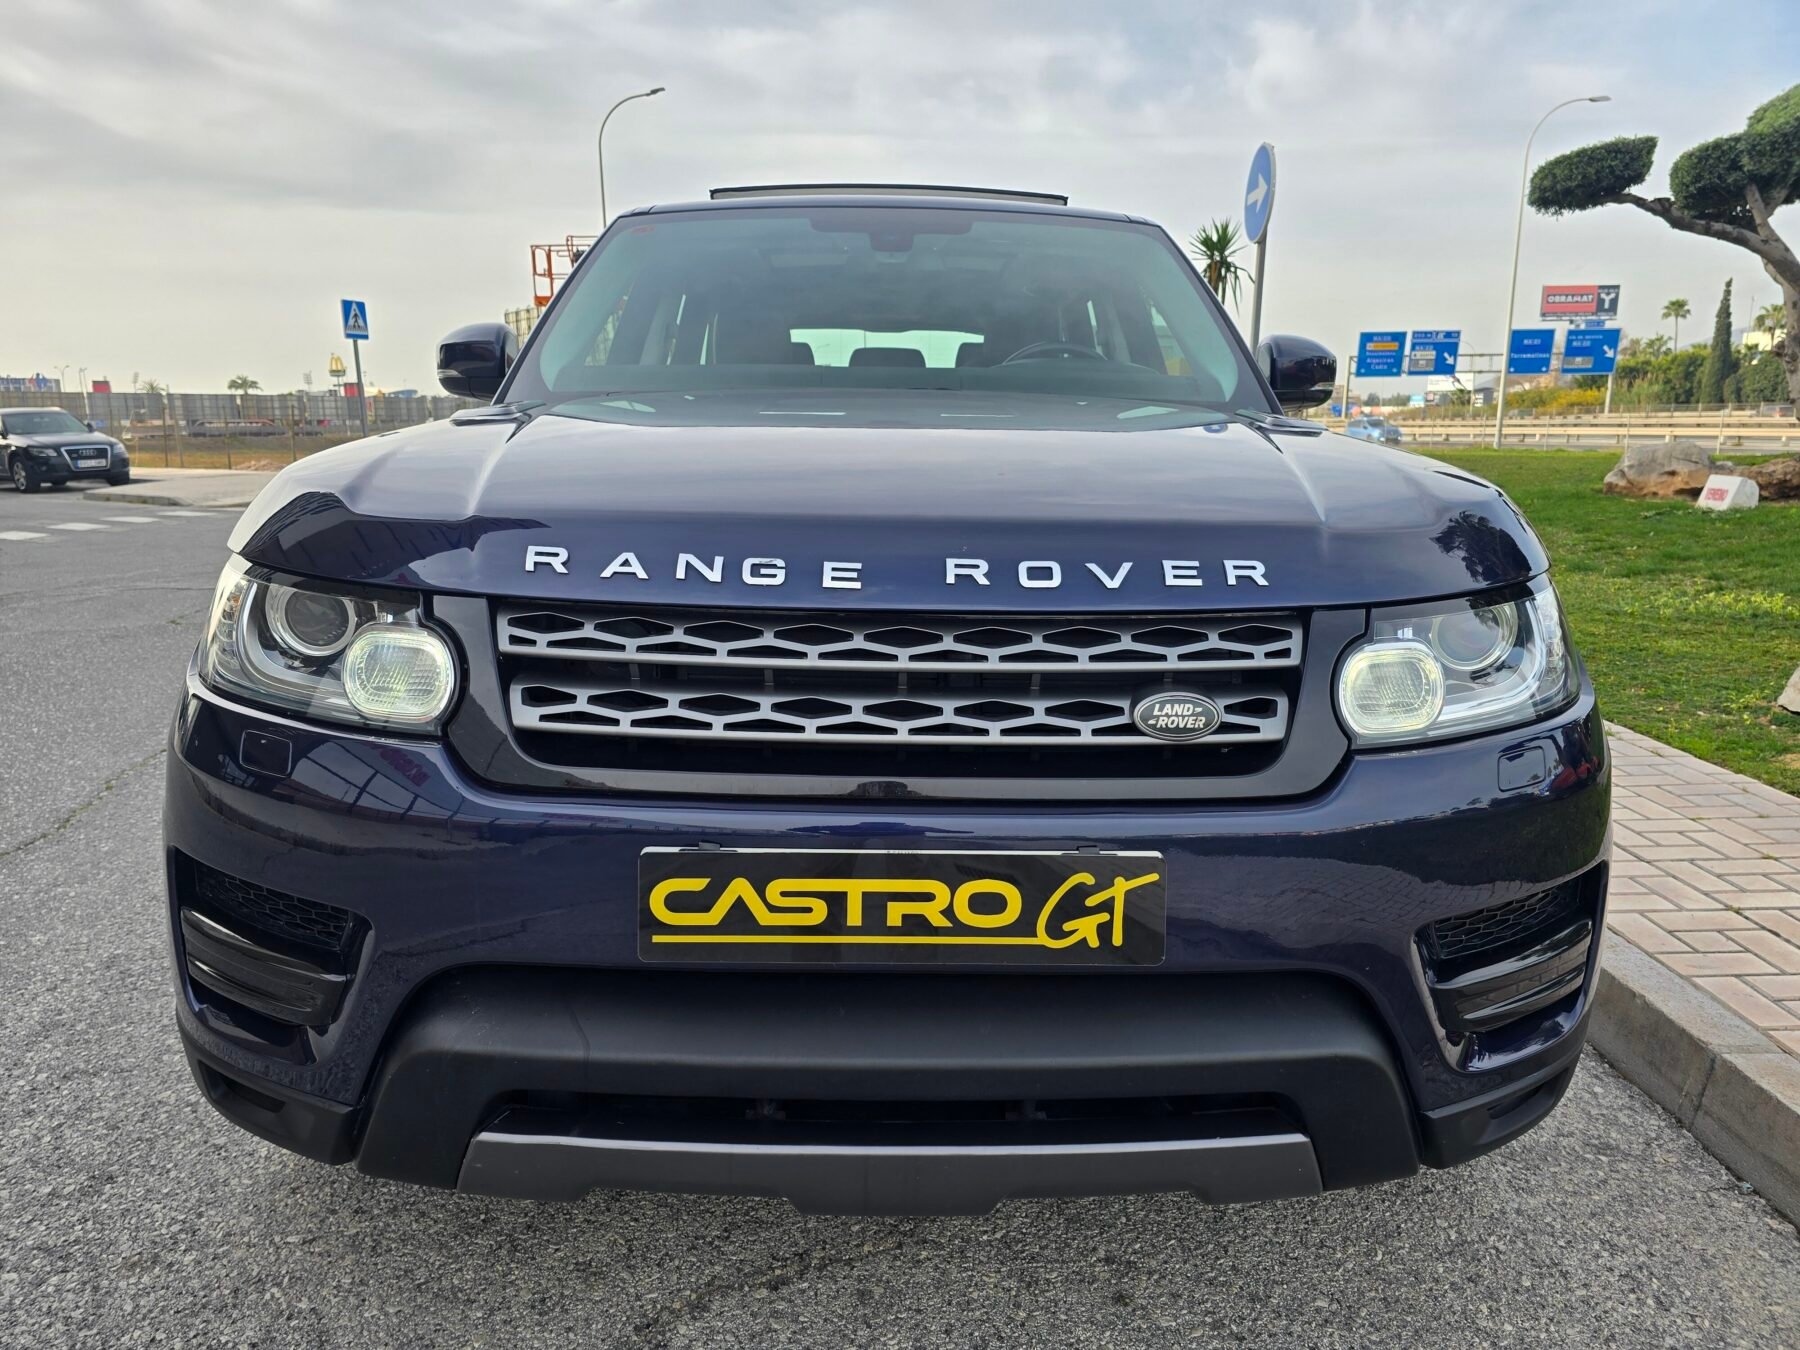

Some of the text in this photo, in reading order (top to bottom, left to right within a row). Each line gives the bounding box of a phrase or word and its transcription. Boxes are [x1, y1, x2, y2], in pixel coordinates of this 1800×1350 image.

[1547, 294, 1594, 304] OBRAMAT
[525, 545, 1270, 589] RANGE ROVER
[1156, 716, 1206, 729] ROVER
[649, 872, 1160, 949] CASTRO GT
